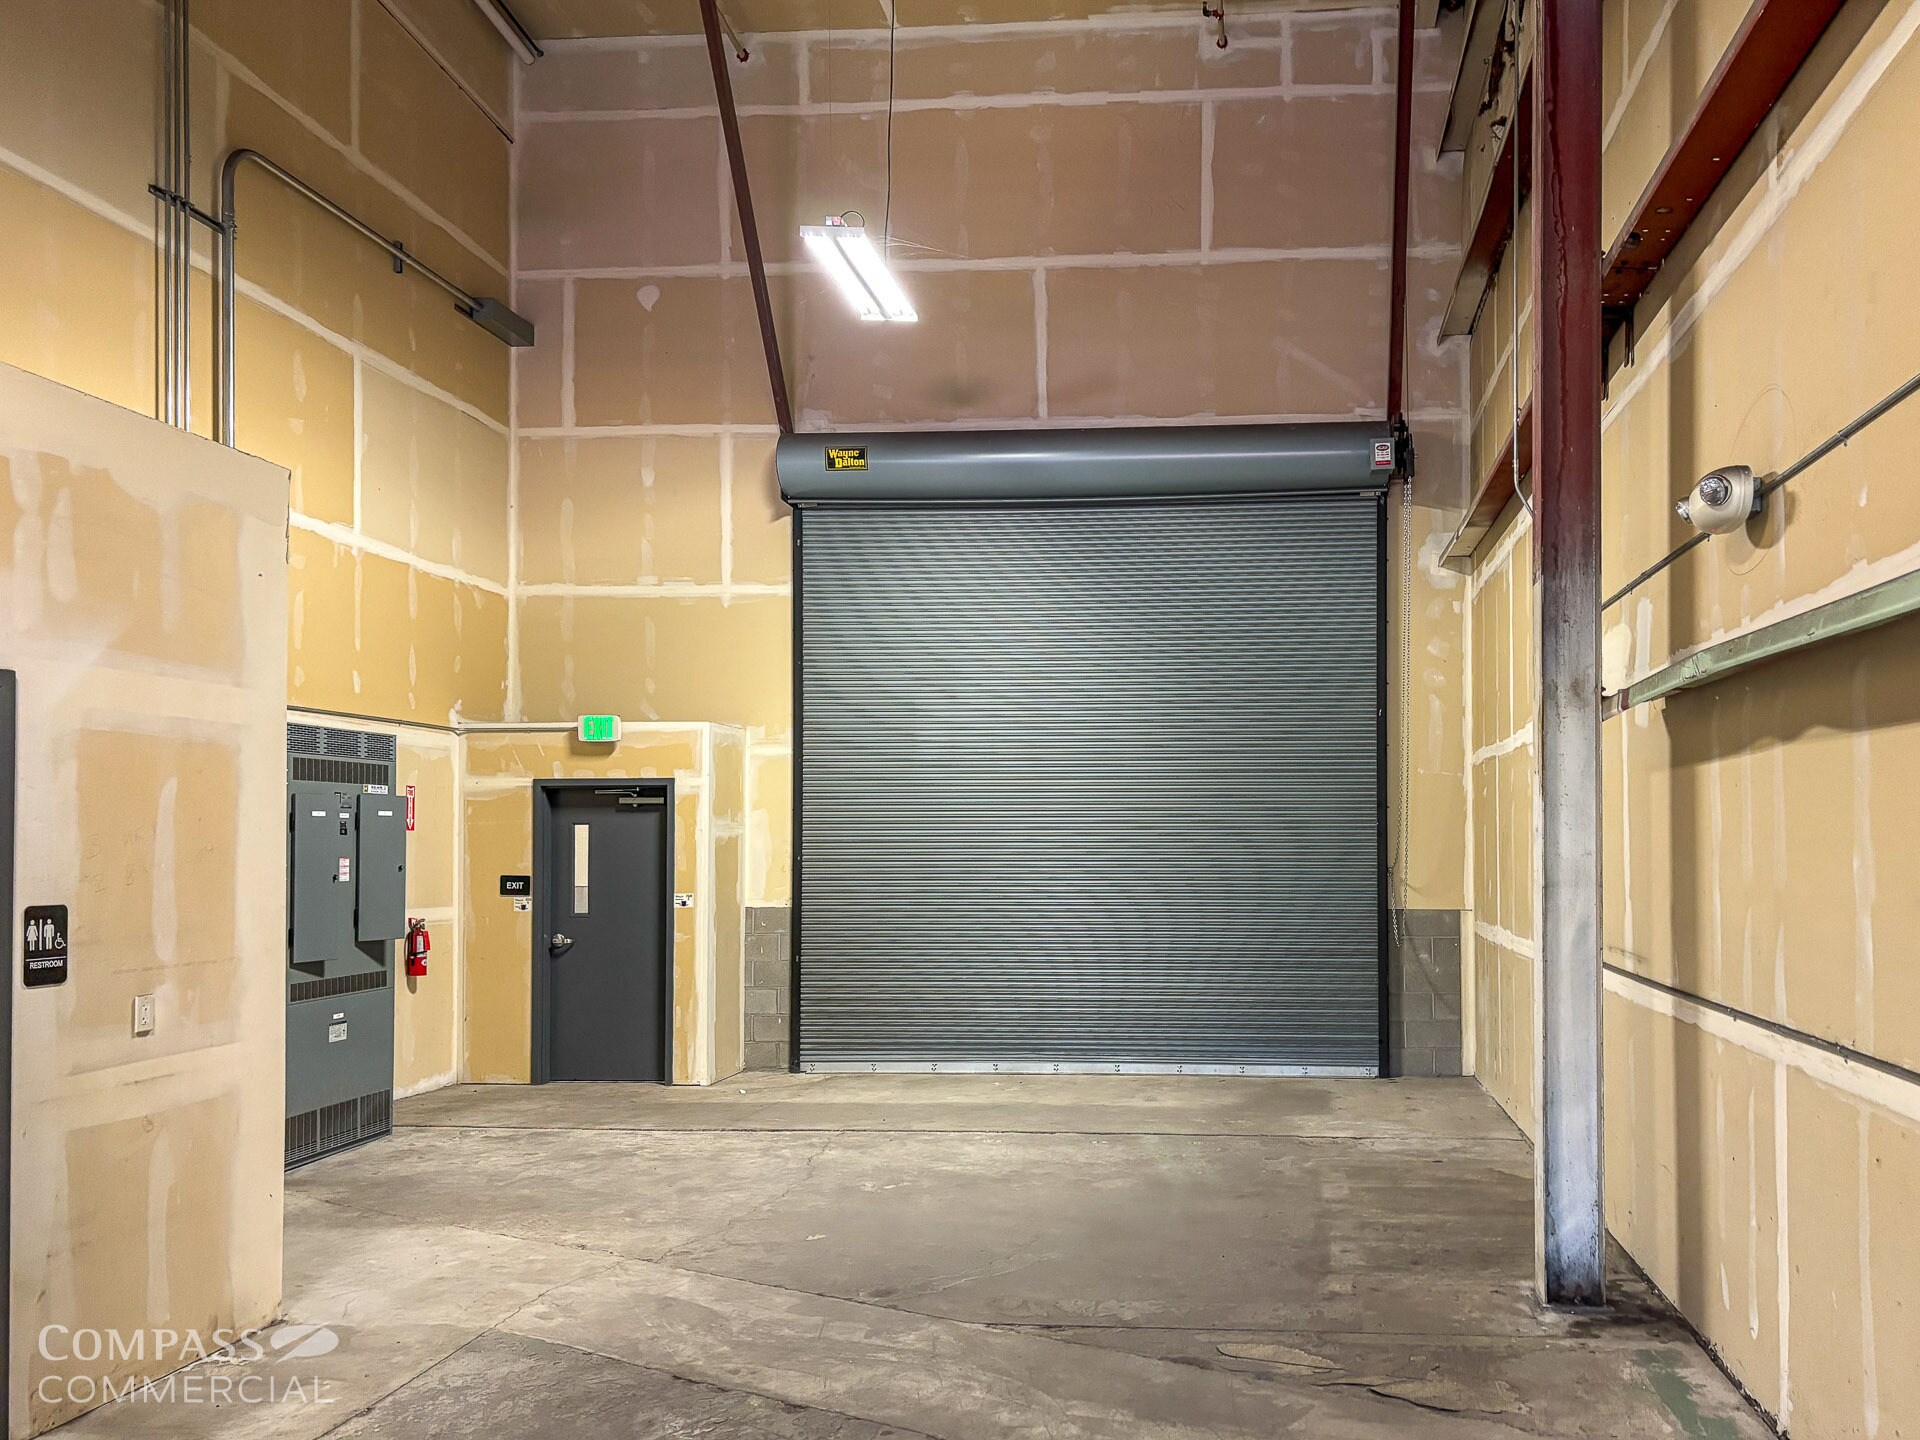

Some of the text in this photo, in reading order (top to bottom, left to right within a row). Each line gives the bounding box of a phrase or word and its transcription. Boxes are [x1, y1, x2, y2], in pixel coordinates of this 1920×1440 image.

[828, 449, 860, 460] Wayne
[835, 458, 865, 468] Dalton
[584, 716, 613, 740] EXIT
[506, 881, 525, 890] EXIT
[29, 960, 64, 970] RESTROOM
